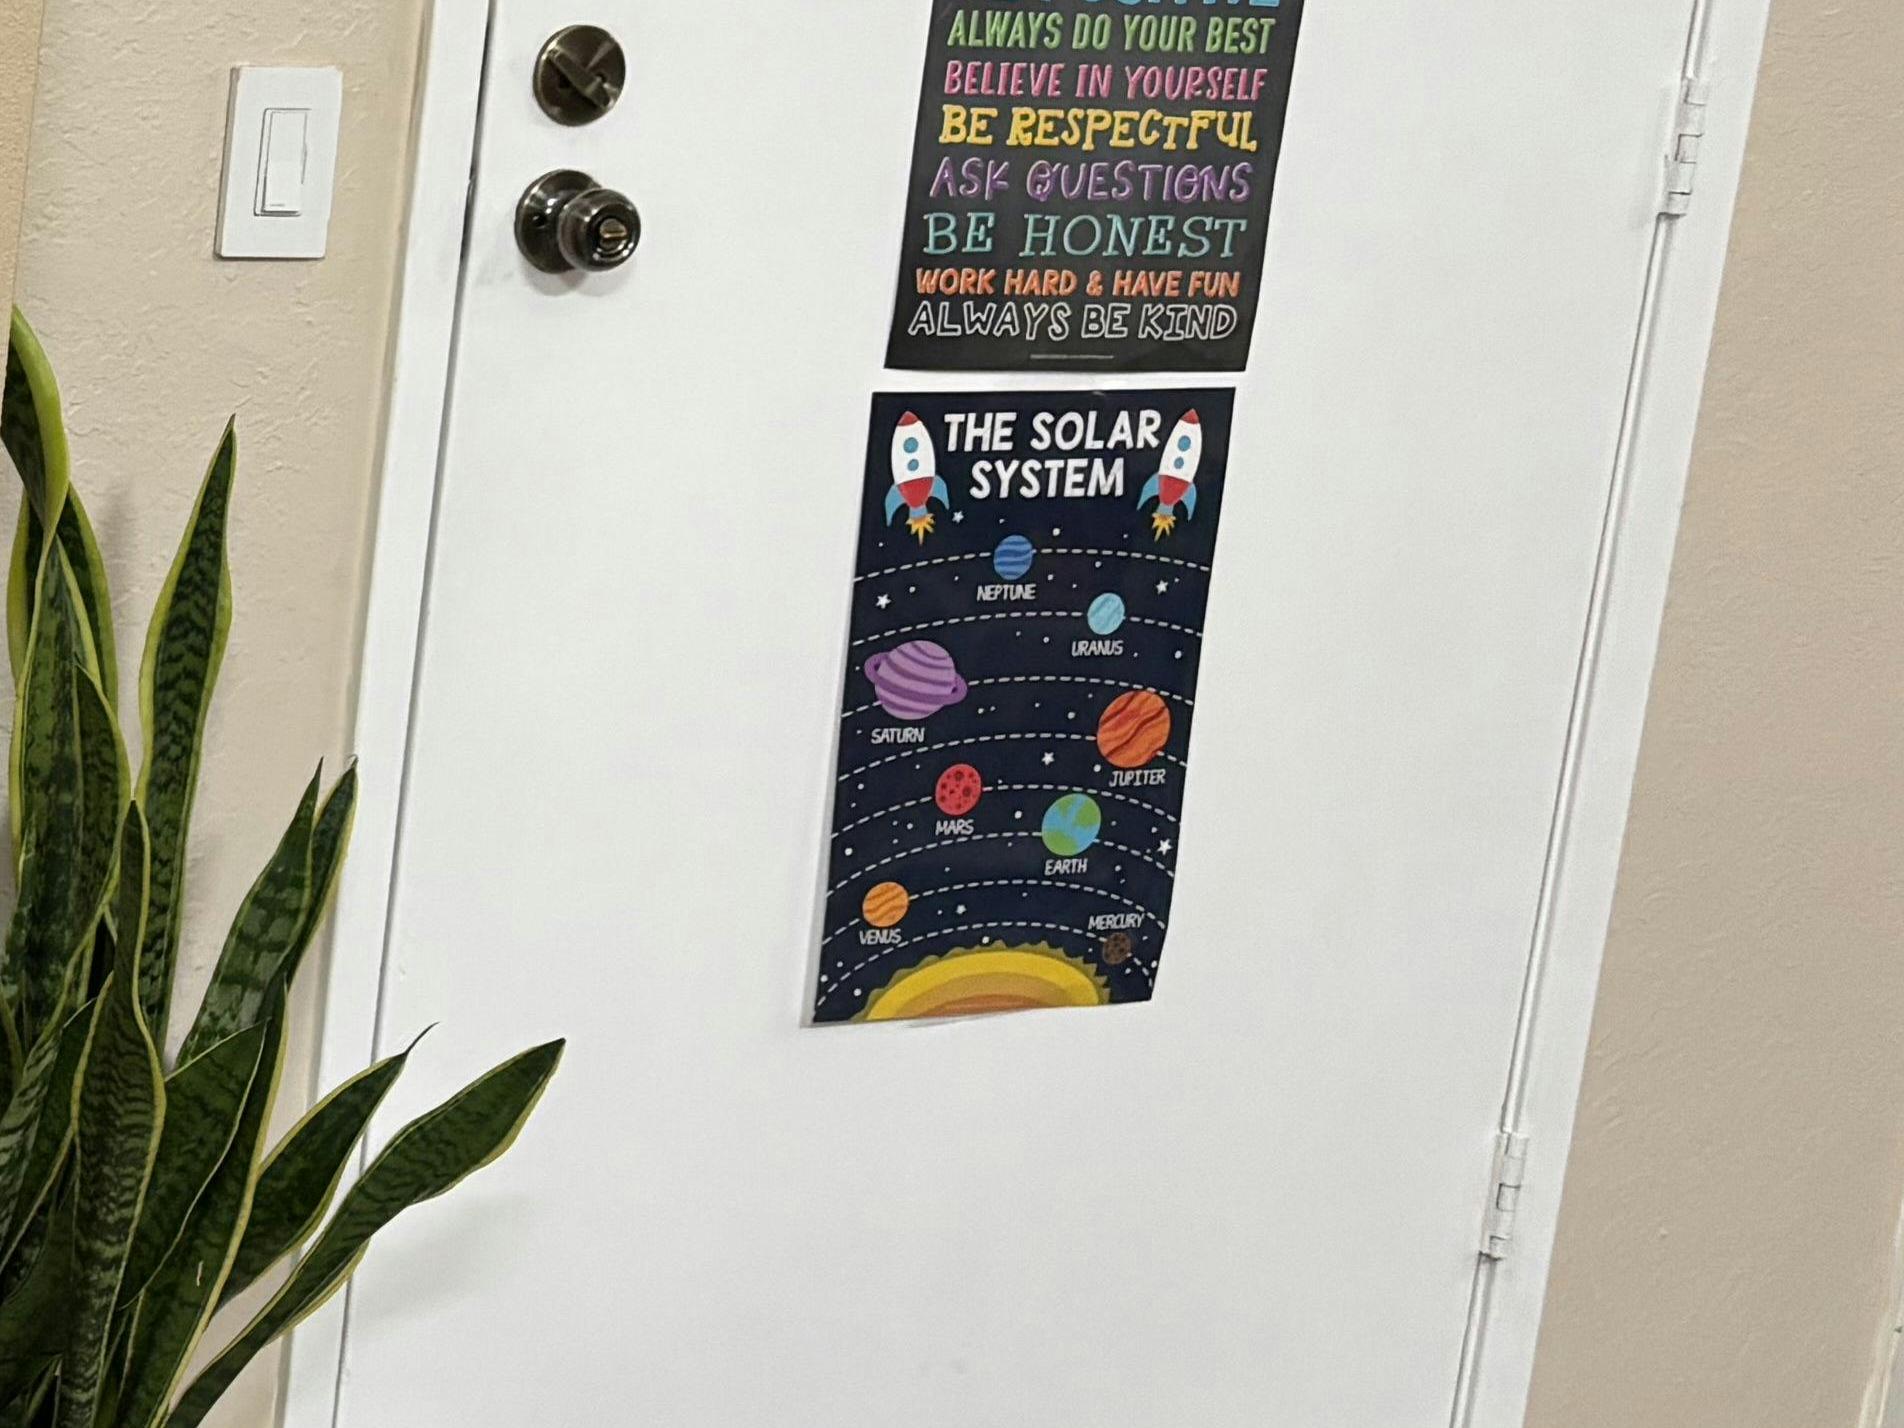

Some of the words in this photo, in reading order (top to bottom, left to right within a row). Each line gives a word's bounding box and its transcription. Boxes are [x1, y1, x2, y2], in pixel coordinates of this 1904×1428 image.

[947, 10, 1063, 50] ALWAYS
[1072, 13, 1115, 52] DO
[1122, 14, 1199, 52] YOUR
[1205, 17, 1276, 53] BEST
[944, 59, 1064, 98] BELIEVE
[1075, 64, 1114, 100] IN
[1124, 65, 1268, 102] YOURSELF
[938, 103, 998, 146] BE
[1005, 106, 1258, 153] RESPECTFUL
[929, 156, 1010, 201] ASK
[1025, 160, 1255, 205] QUESTIONS
[923, 212, 996, 257] BE
[1019, 214, 1248, 261] HONEST
[915, 268, 996, 297] WORK
[1003, 268, 1078, 298] HARD
[1086, 269, 1104, 298] &
[1112, 270, 1181, 299] HAVE
[1187, 270, 1241, 299] FUN
[907, 301, 1072, 343] ALWAYS
[1080, 303, 1129, 339] BE
[1137, 304, 1239, 342] KIND
[943, 412, 1018, 454] THE
[1029, 408, 1162, 452] SOLAR
[968, 458, 1125, 500] SYSTEM
[976, 583, 1037, 602] NEPTUNE
[1071, 639, 1124, 657] URANUS
[870, 727, 925, 744] SATURN
[1107, 768, 1167, 788] JUPITER
[935, 819, 975, 836] MARS
[1044, 858, 1088, 875] EARTH
[1087, 912, 1145, 930] MERCURY
[858, 929, 902, 945] VENUS
